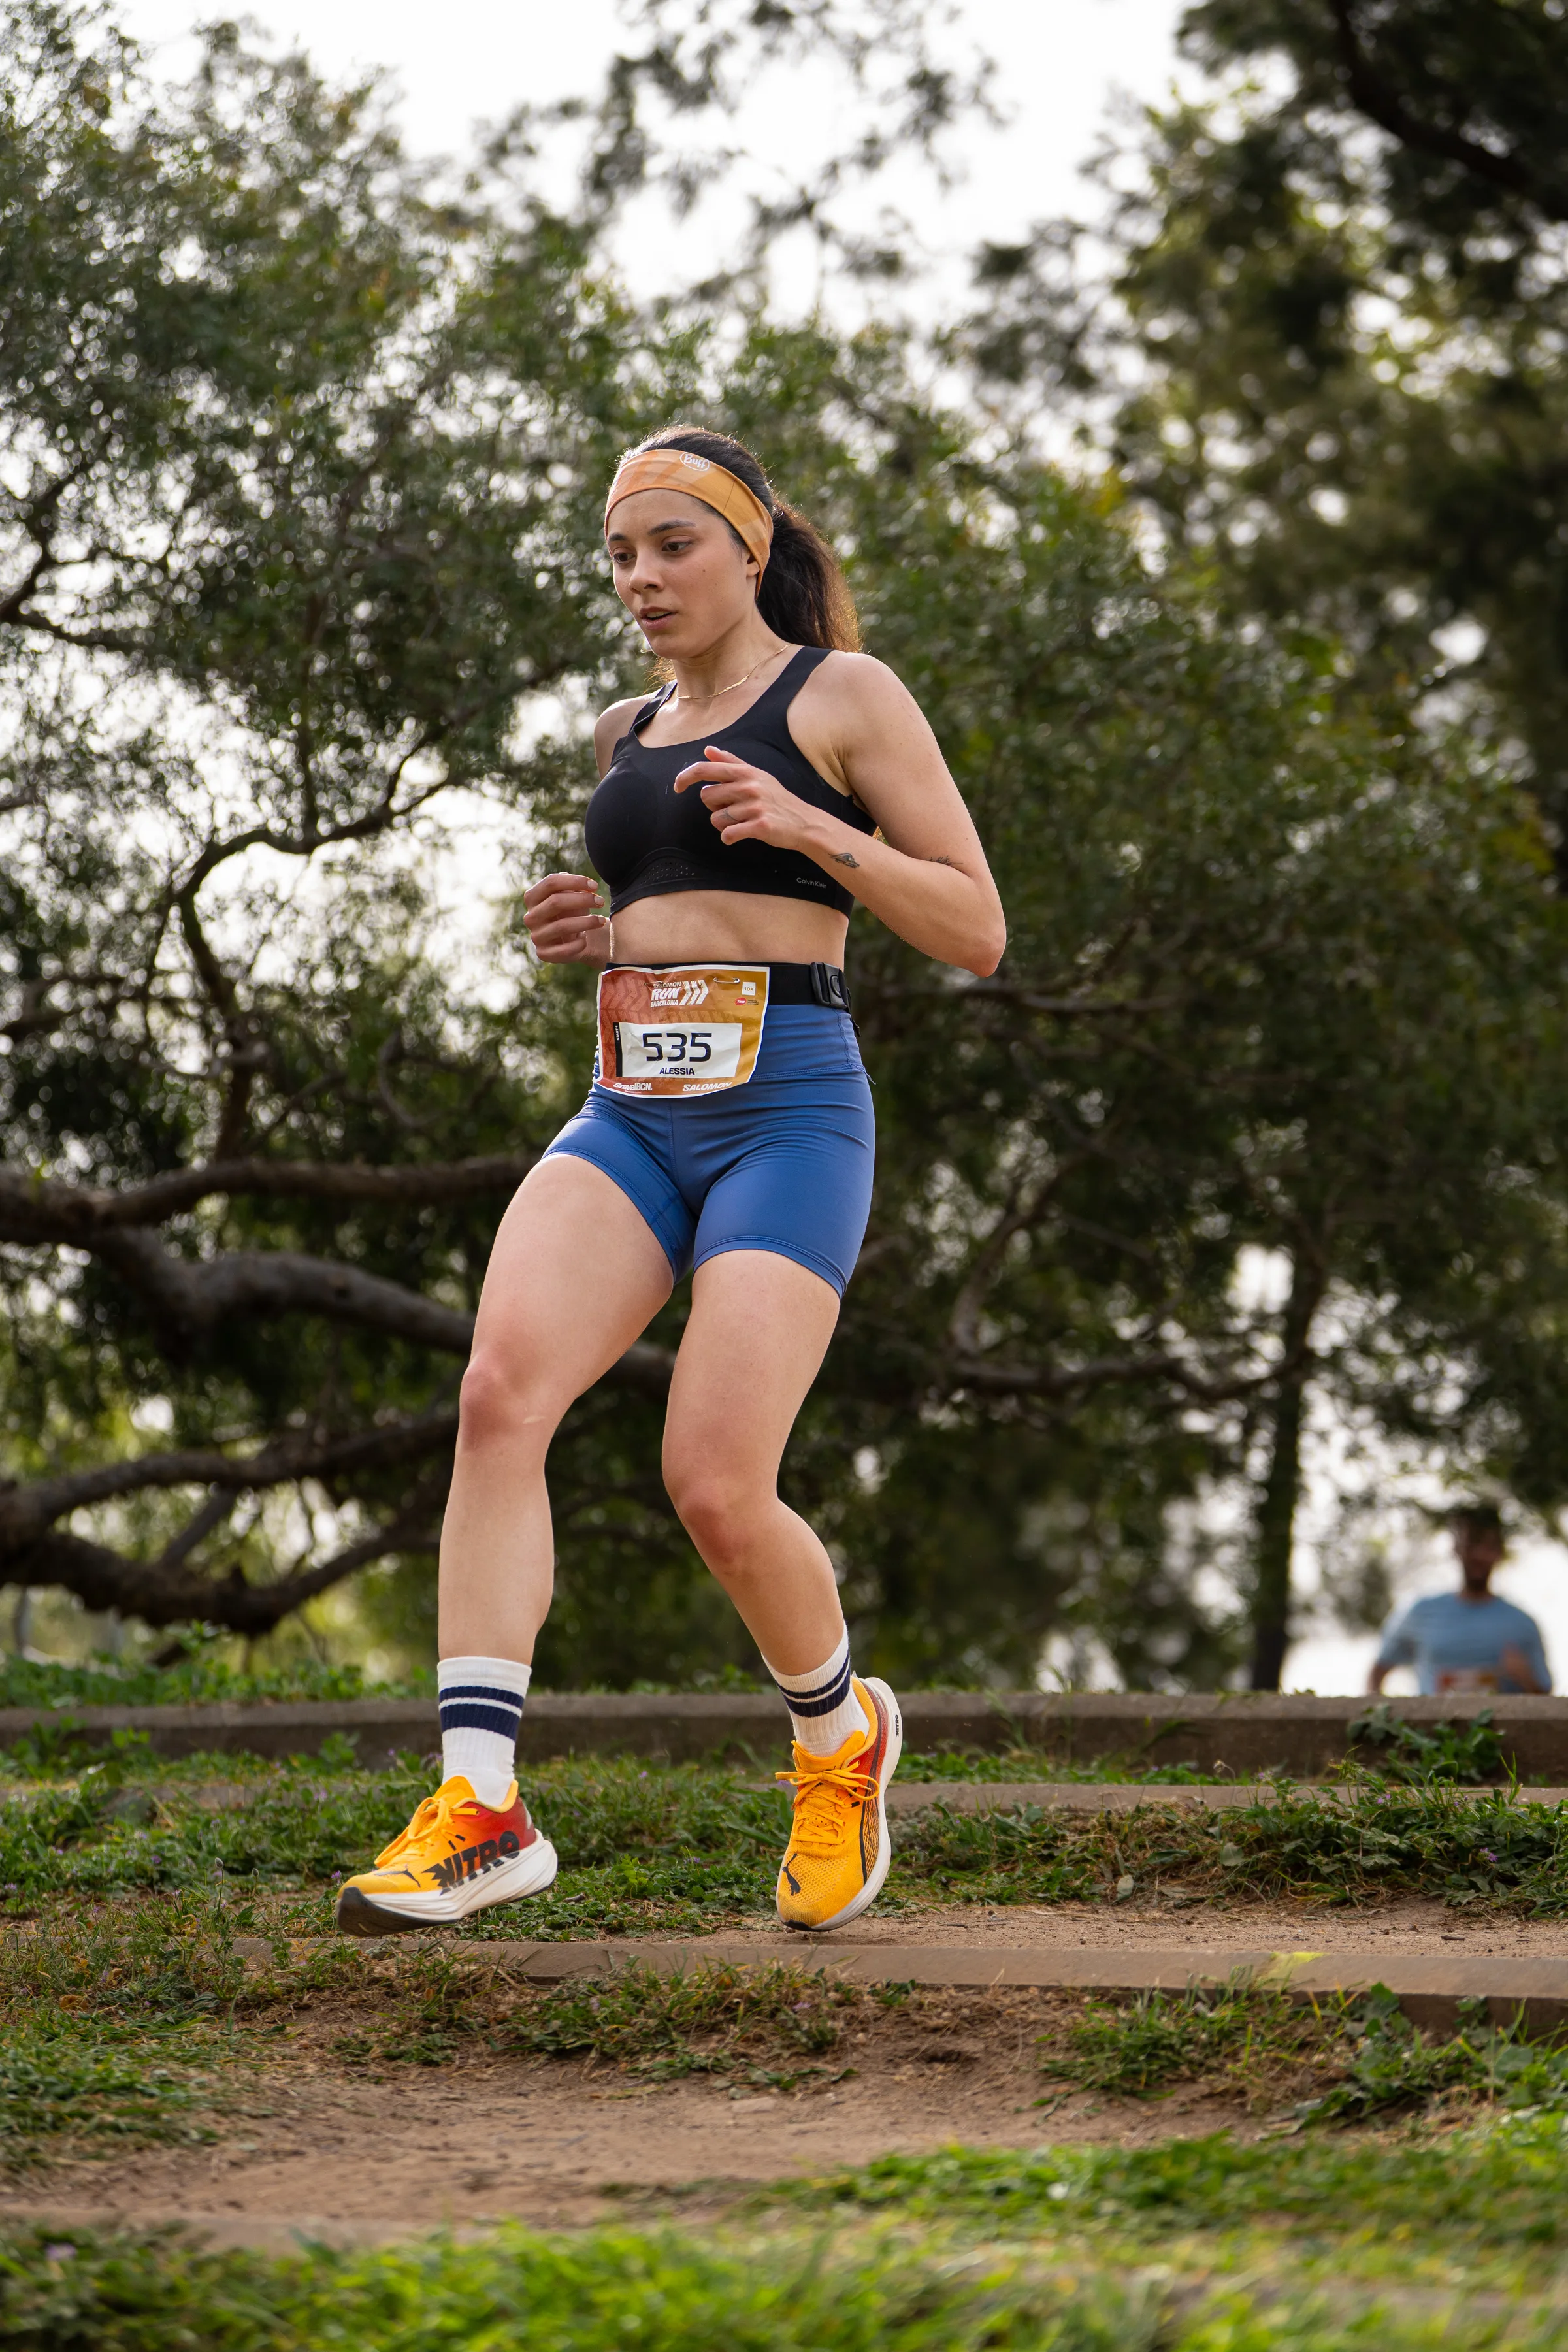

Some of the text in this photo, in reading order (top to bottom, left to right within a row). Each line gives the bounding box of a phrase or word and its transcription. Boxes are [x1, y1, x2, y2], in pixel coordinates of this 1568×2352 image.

[683, 453, 708, 469] Buff
[796, 877, 815, 886] Calvin
[651, 987, 681, 1000] RUN
[642, 1032, 712, 1062] 535
[659, 1067, 695, 1075] ALESSIA
[682, 1081, 733, 1092] SALOMON
[421, 1831, 520, 1896] NITRO
